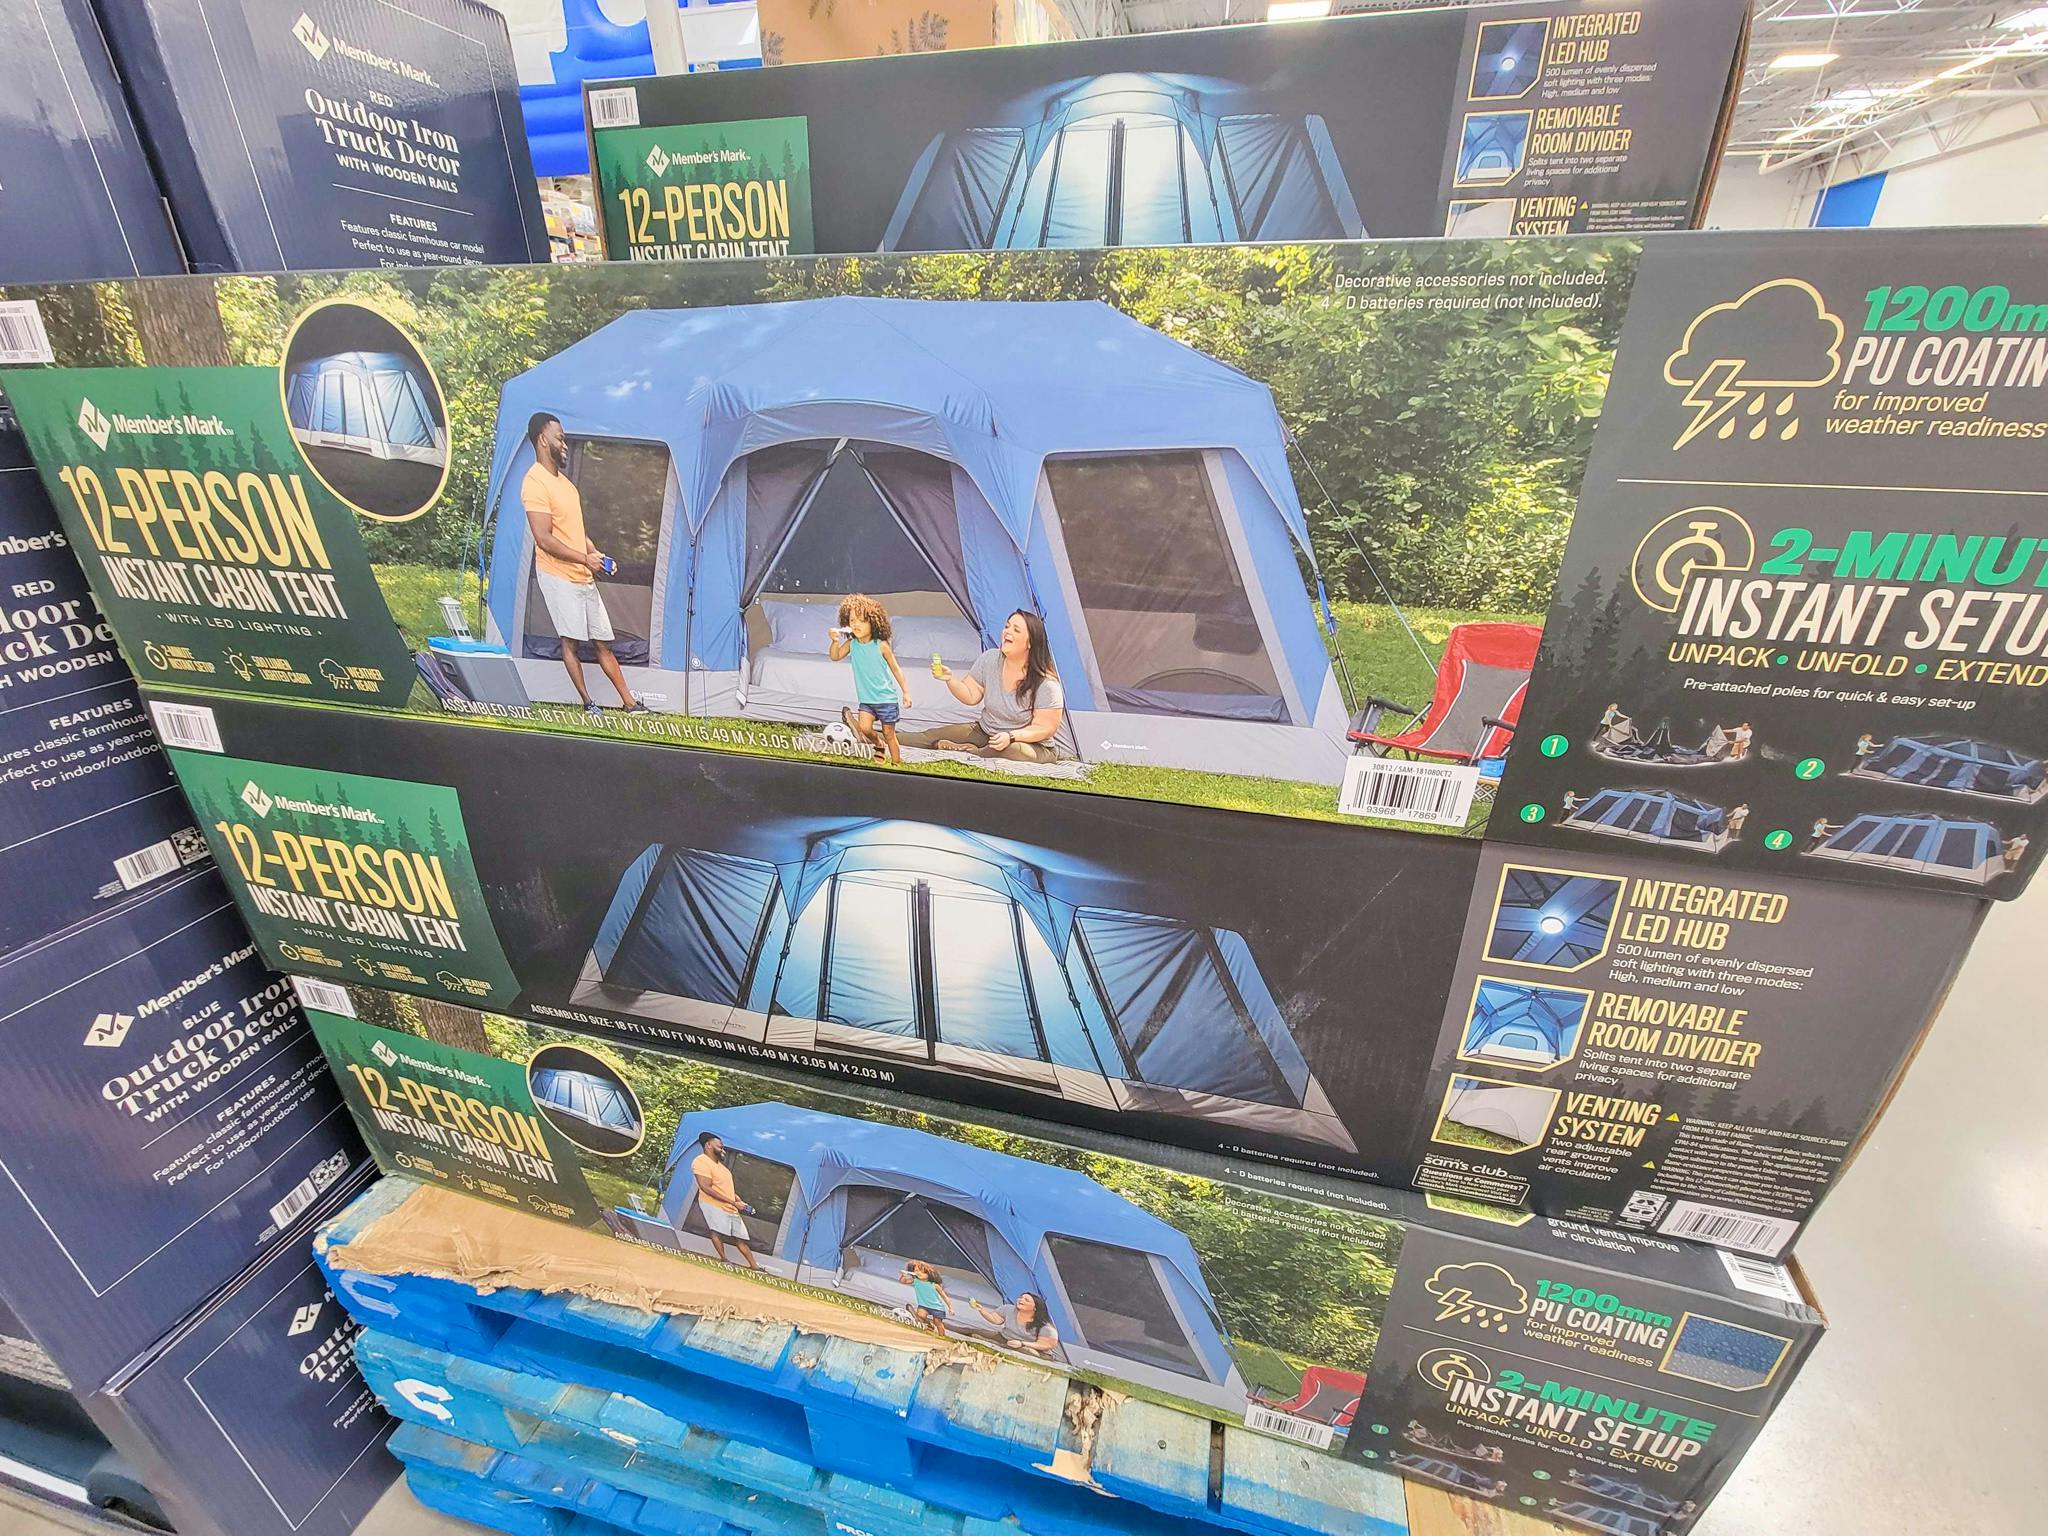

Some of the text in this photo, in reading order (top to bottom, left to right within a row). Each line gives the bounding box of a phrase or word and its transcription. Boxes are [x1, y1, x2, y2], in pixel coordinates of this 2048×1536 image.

[1553, 11, 1641, 39] INTEGRATED
[1548, 40, 1610, 65] LED HUB
[369, 91, 393, 107] RED
[304, 88, 460, 153] Outdoor Iron
[1536, 104, 1622, 130] REMOVABLE
[315, 117, 460, 176] Truck Decor
[672, 151, 719, 165] Member's
[1530, 130, 1632, 155] ROOM DIVIDER
[335, 153, 458, 193] WITH WOODEN RAILS
[390, 214, 437, 231] FEATURES
[618, 179, 789, 243] 12-PERSON
[1519, 197, 1577, 217] VENTING
[382, 228, 407, 241] classic
[1335, 271, 1608, 288] Decorative accessories not included.
[1360, 294, 1602, 311] batteries required (not included).
[1842, 337, 1905, 385] PU
[1833, 391, 1987, 415] for improved
[112, 414, 183, 435] Member's
[1826, 416, 2046, 439] weather readiness
[59, 464, 332, 569] 12-PERSON
[12, 580, 55, 598] RED
[100, 556, 348, 620] INSTANT CABIN TENT
[166, 612, 312, 637] WITH LED LIGHTING
[1678, 578, 1910, 646] INSTANT
[17, 651, 114, 682] WOODEN
[1668, 642, 2048, 687] UNPACK UNFOLD EXTEND
[1684, 678, 1975, 711] Pre-attached poles for quick easy set-up
[50, 699, 133, 730] FEATURES
[34, 733, 80, 753] classic
[63, 750, 85, 763] use
[31, 777, 56, 790] For
[274, 795, 340, 818] Member's
[1367, 806, 1436, 820] 93968 17869
[214, 821, 458, 920] 12-PERSON
[1630, 878, 1788, 924] INTEGRATED
[246, 883, 467, 952] INSTANT CABIN TENT
[1620, 912, 1730, 951] LED HUB
[302, 928, 434, 959] WITH LED LIGHTING
[1612, 958, 1804, 991] soft lighting with three modes:
[1616, 944, 1814, 979] 500 lumen of evenly dispersed
[1608, 970, 1745, 996] High, medium and low
[182, 1001, 221, 1030] BLUE
[1596, 992, 1748, 1036] REMOVABLE
[102, 1011, 235, 1102] Outdoor
[530, 1004, 877, 1079] ASSEMBLED SIZE: 18 (5.49 3.05 2.03
[1588, 1022, 1762, 1068] ROOM DIVIDER
[144, 1017, 298, 1123] WITH WOODEN RAILS
[399, 1054, 454, 1078] Member's
[1575, 1072, 1619, 1085] privacy
[1579, 1061, 1737, 1091] living spaces for additional
[1583, 1049, 1752, 1081] Splits tent into two separate
[116, 1047, 222, 1116] Truck
[216, 1075, 277, 1122] FEATURES
[347, 1064, 552, 1161] 12-PERSON
[1566, 1092, 1662, 1126] VENTING
[205, 1088, 316, 1175] For use
[372, 1108, 451, 1147] INSTANT
[450, 1130, 510, 1168] CABIN
[507, 1150, 559, 1184] TENT
[1554, 1116, 1647, 1148] SYSTEM
[420, 1142, 528, 1184] WITH LED LIGHTING
[1241, 1147, 1316, 1168] batteries required
[1424, 1156, 1469, 1170] sam's
[1546, 1147, 1610, 1164] rear ground
[1550, 1137, 1633, 1158] Two adjustable
[1422, 1168, 1462, 1179] Questions
[1542, 1156, 1619, 1174] vents improve
[1555, 1166, 1612, 1182] circulation
[1248, 1172, 1325, 1195] batteries required
[1547, 1218, 1593, 1233] ground
[1628, 1234, 1680, 1253] improve
[1570, 1232, 1636, 1254] circulation
[1536, 1279, 1673, 1328] 1200mm
[1526, 1318, 1615, 1348] for improved
[1530, 1299, 1669, 1349] PU COATING
[1523, 1328, 1653, 1367] weather readiness
[1450, 1379, 1701, 1464] INSTANT SETUP
[1496, 1370, 1718, 1444] 2-MINUTE
[1446, 1404, 1679, 1473] UNPACK UNFOLD EXTEND
